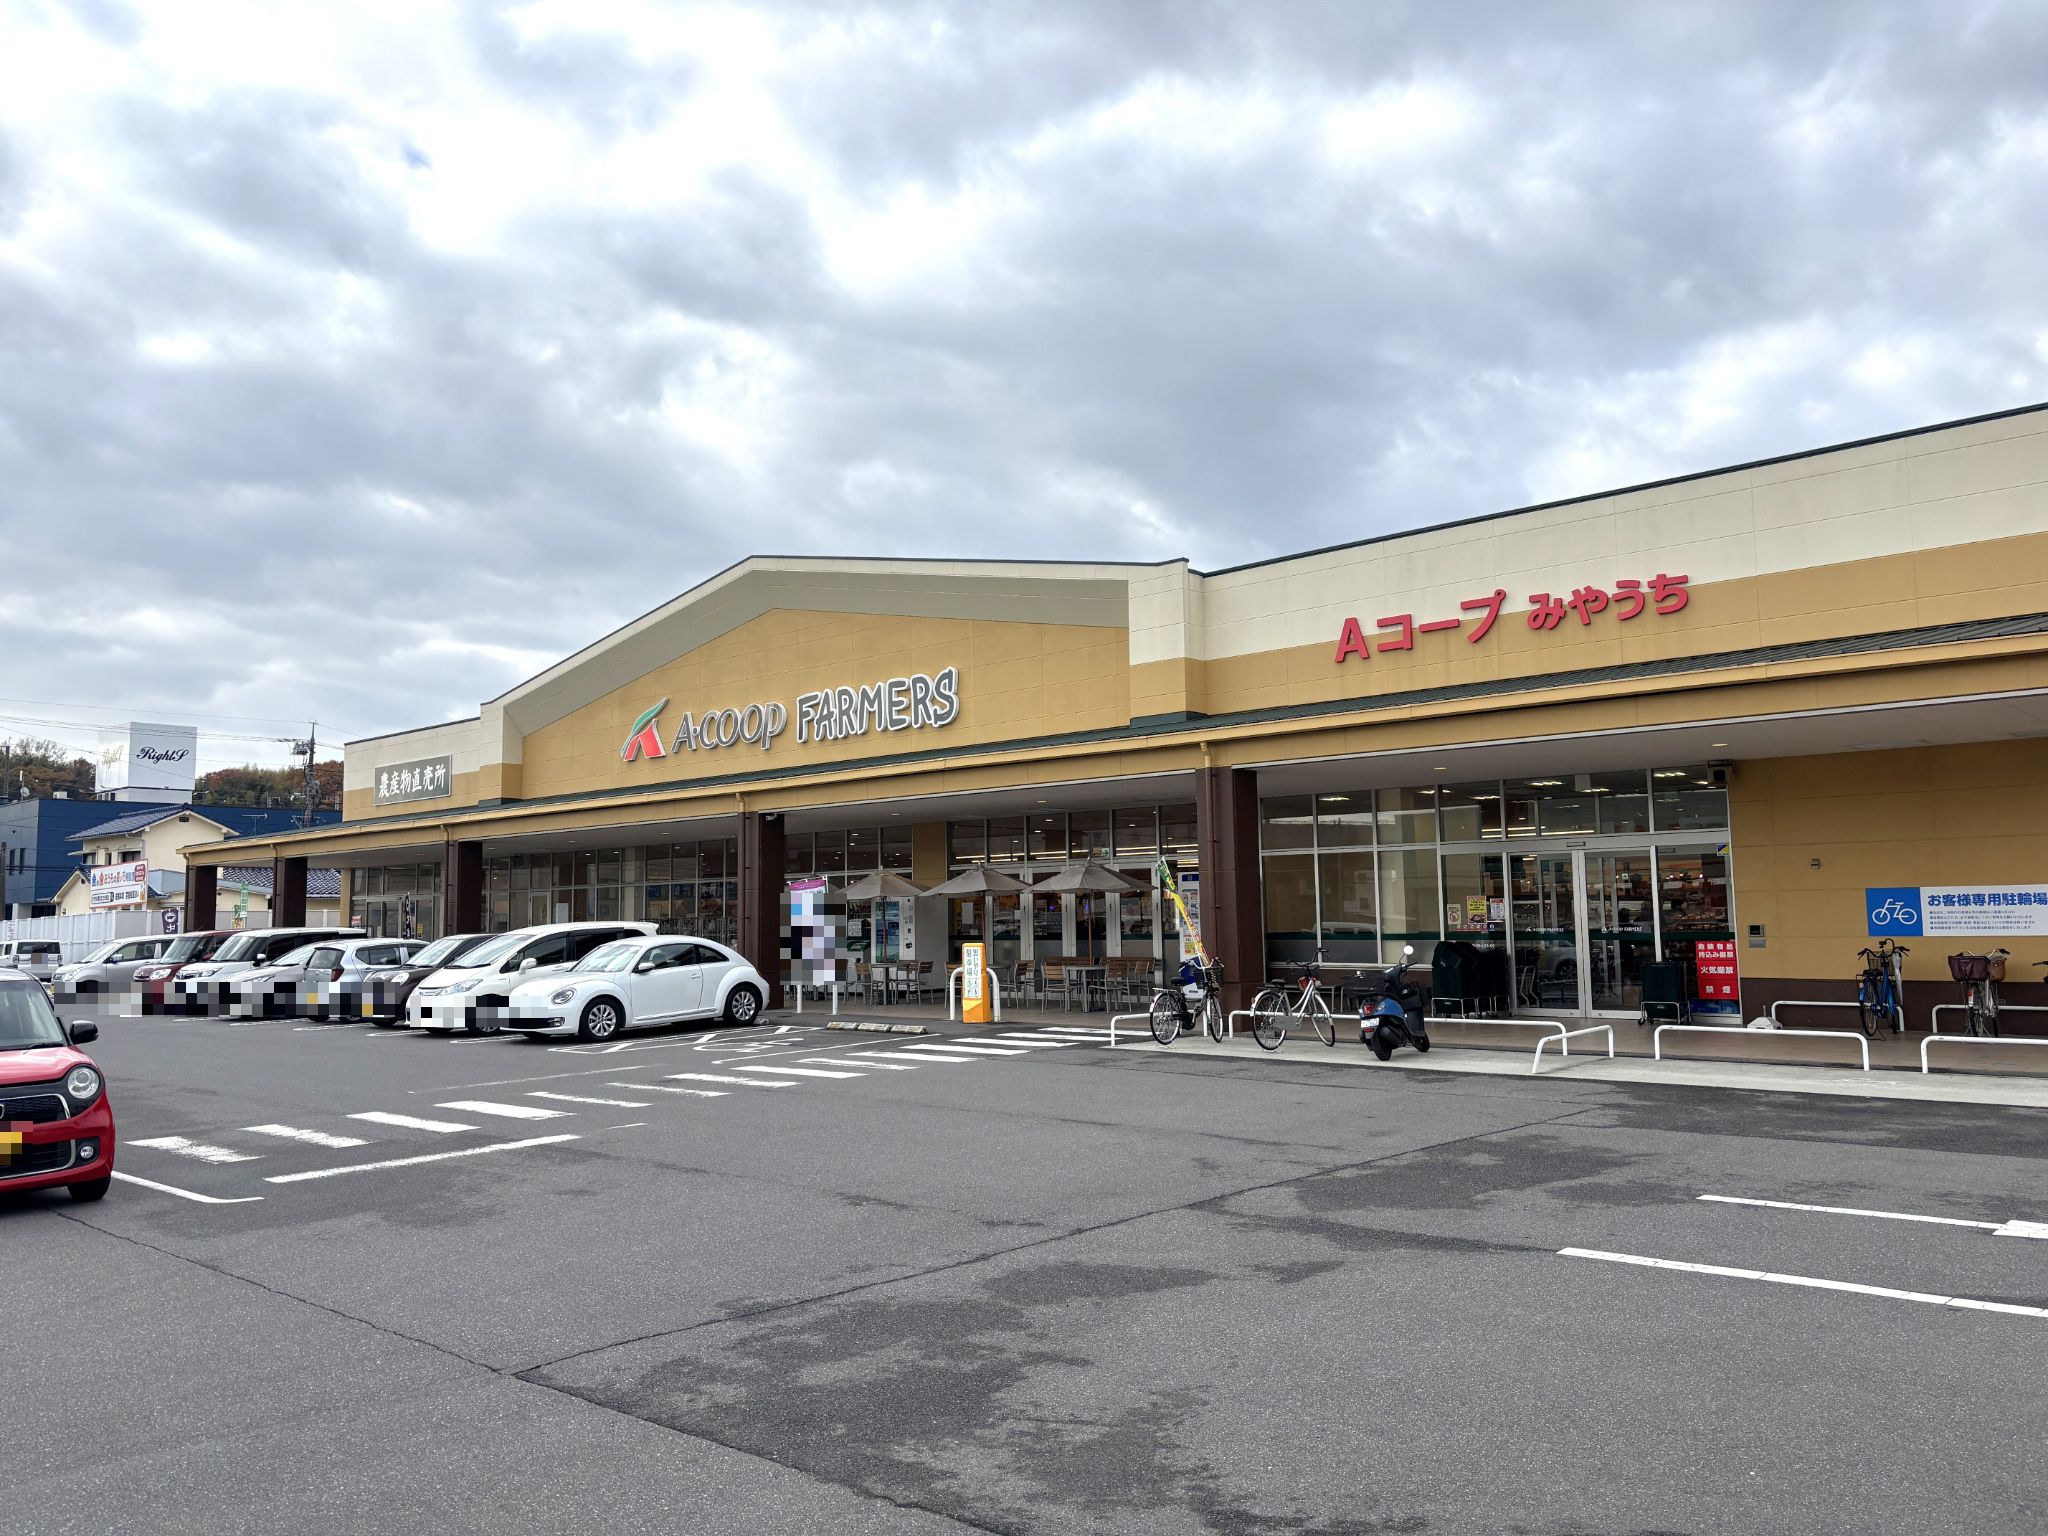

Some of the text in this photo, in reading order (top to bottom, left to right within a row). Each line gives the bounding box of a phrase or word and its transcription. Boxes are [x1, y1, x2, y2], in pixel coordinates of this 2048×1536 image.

[1335, 573, 1690, 664] Aコープ みやうち
[797, 666, 960, 744] FARMERS
[379, 763, 447, 798] 農産物直売所
[1928, 892, 2048, 907] お客様専用駐輪場
[1700, 966, 1734, 974] 火気厳禁
